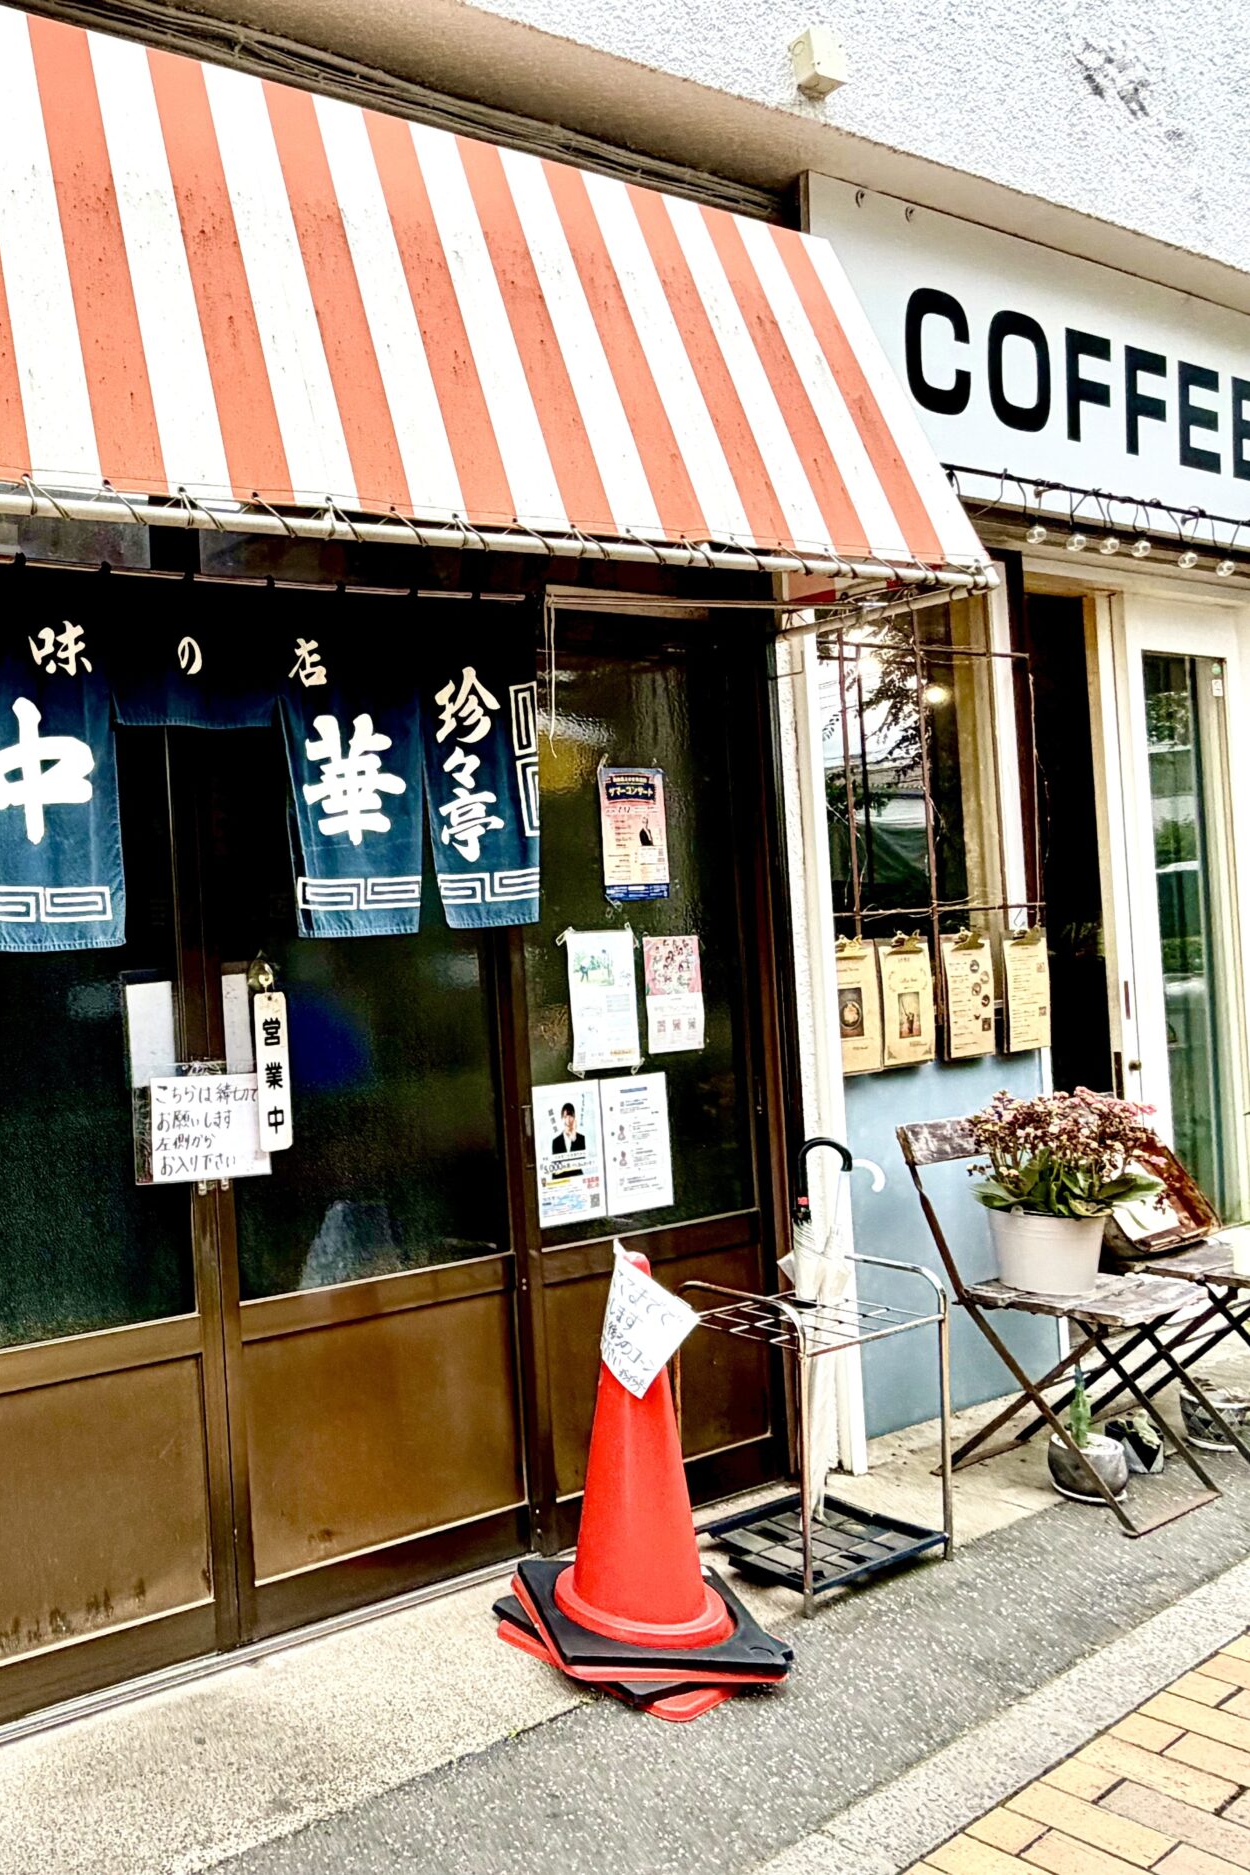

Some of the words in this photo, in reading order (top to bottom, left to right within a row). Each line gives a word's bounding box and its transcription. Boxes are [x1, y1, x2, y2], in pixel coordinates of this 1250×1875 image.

[434, 666, 505, 862] 珍々亭
[262, 1017, 285, 1134] 営業中
[157, 1110, 232, 1132] お願いします
[155, 1133, 215, 1151] 左側から
[160, 1153, 236, 1176] お入り下さい
